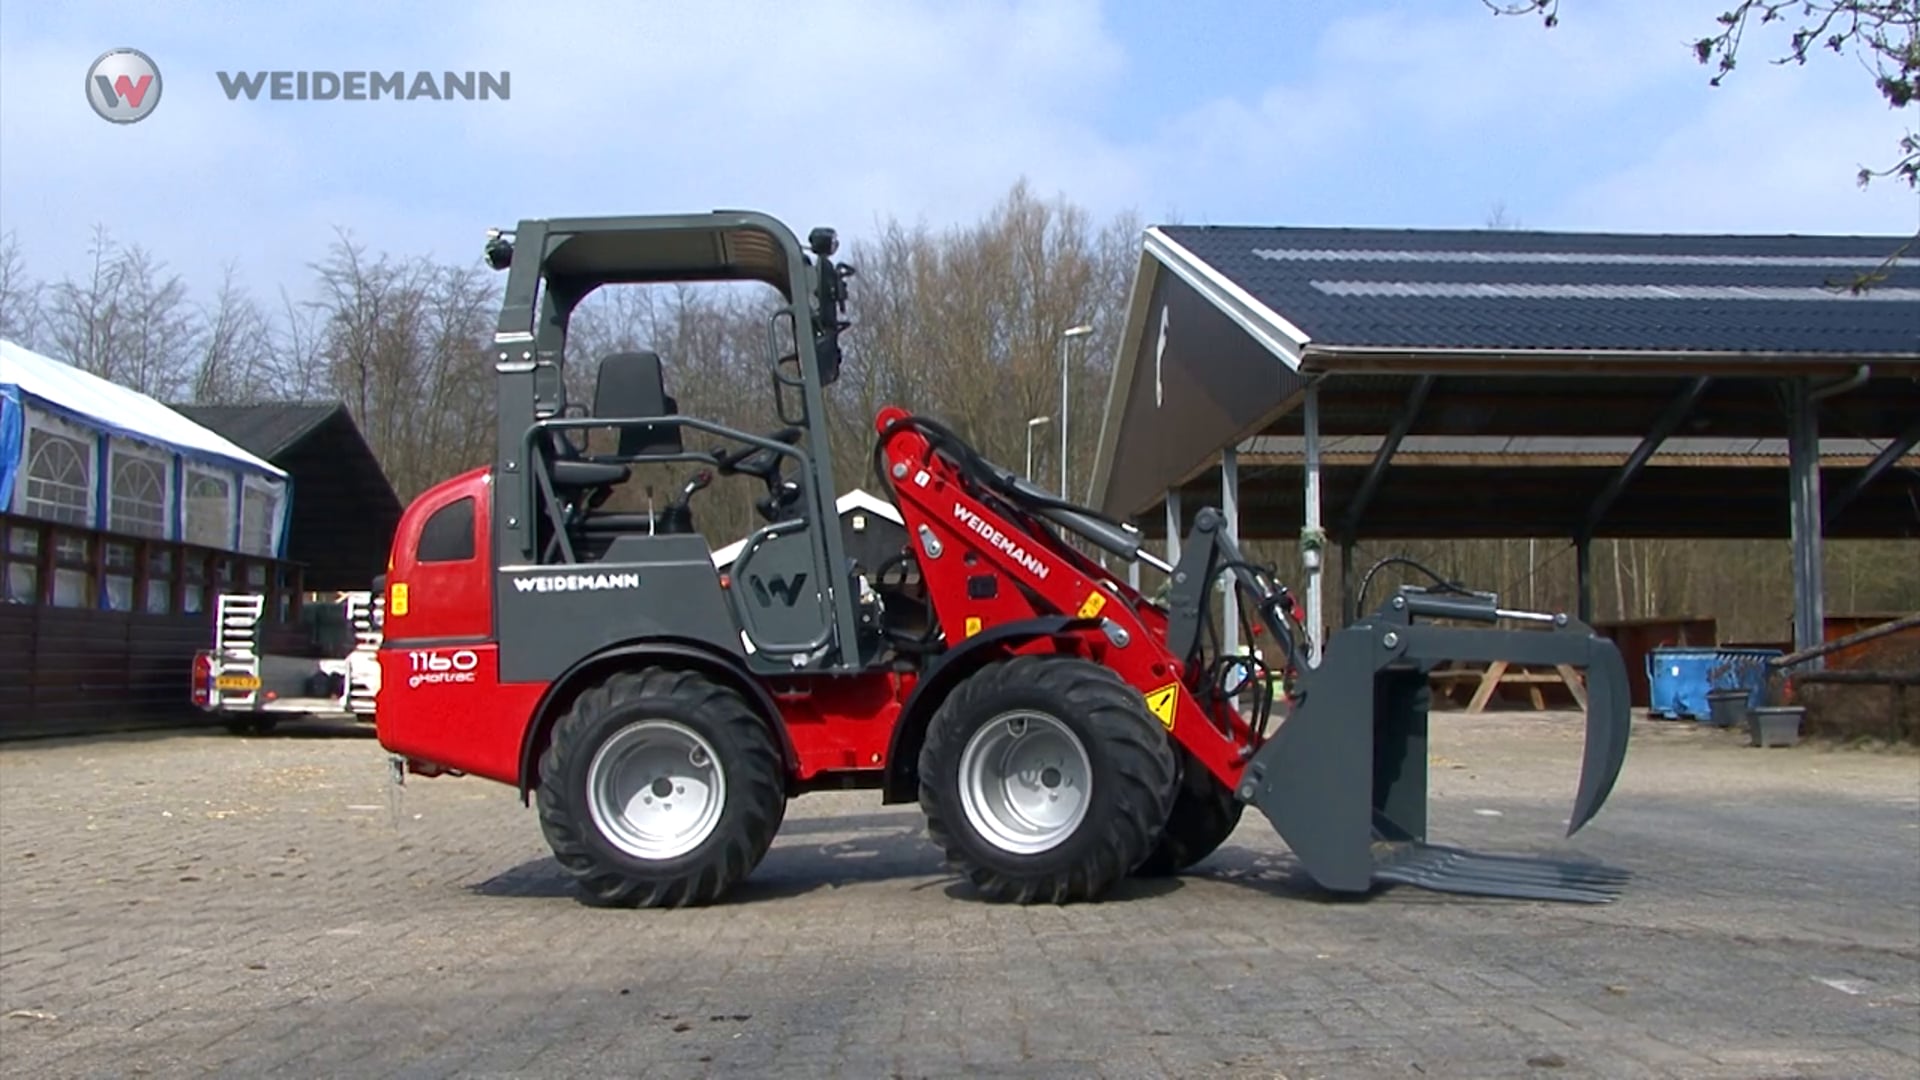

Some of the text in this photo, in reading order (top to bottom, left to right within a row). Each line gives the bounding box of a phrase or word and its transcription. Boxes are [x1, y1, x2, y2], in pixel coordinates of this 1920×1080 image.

[953, 502, 1049, 580] WEIDEMANN
[513, 573, 640, 593] WEIDEMANN
[409, 650, 478, 671] 1160
